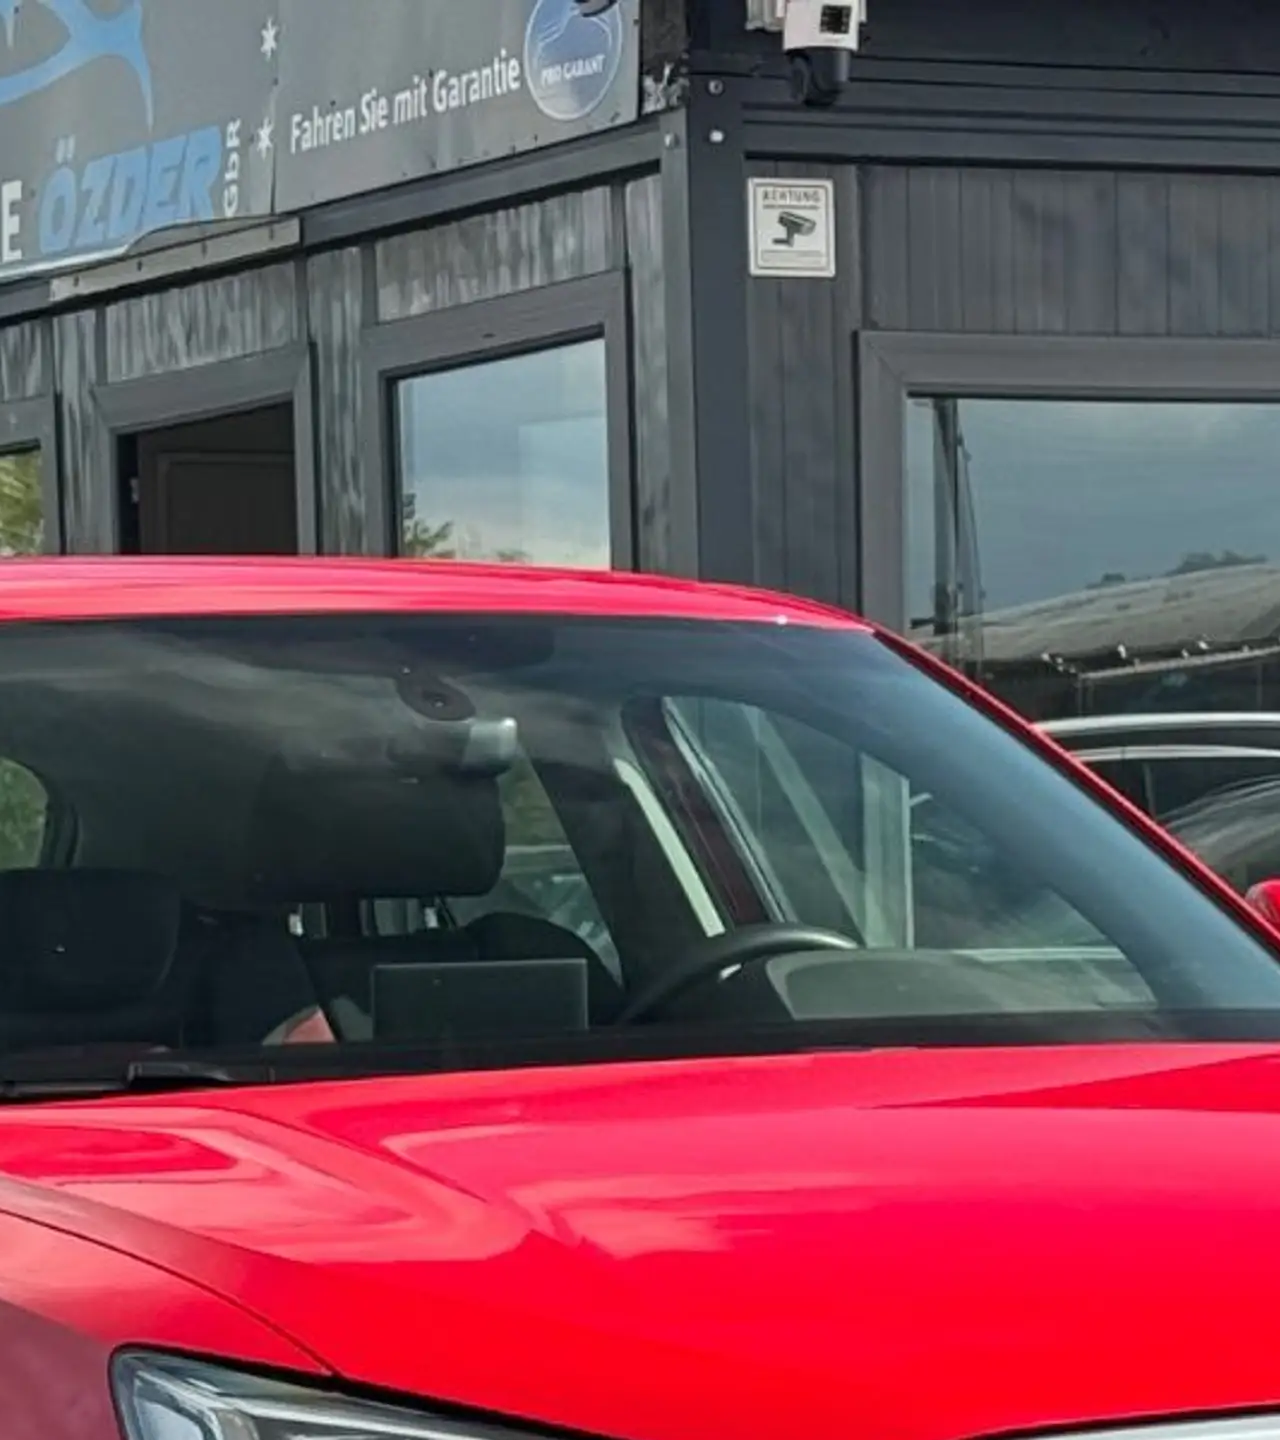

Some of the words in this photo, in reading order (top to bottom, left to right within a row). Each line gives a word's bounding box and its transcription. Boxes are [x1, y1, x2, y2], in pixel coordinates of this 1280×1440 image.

[290, 105, 356, 156] Fahren
[359, 85, 389, 136] Sie
[393, 73, 428, 126] mit
[432, 49, 521, 114] Garantie
[38, 123, 222, 256] ÖZDER
[222, 117, 242, 219] GbR
